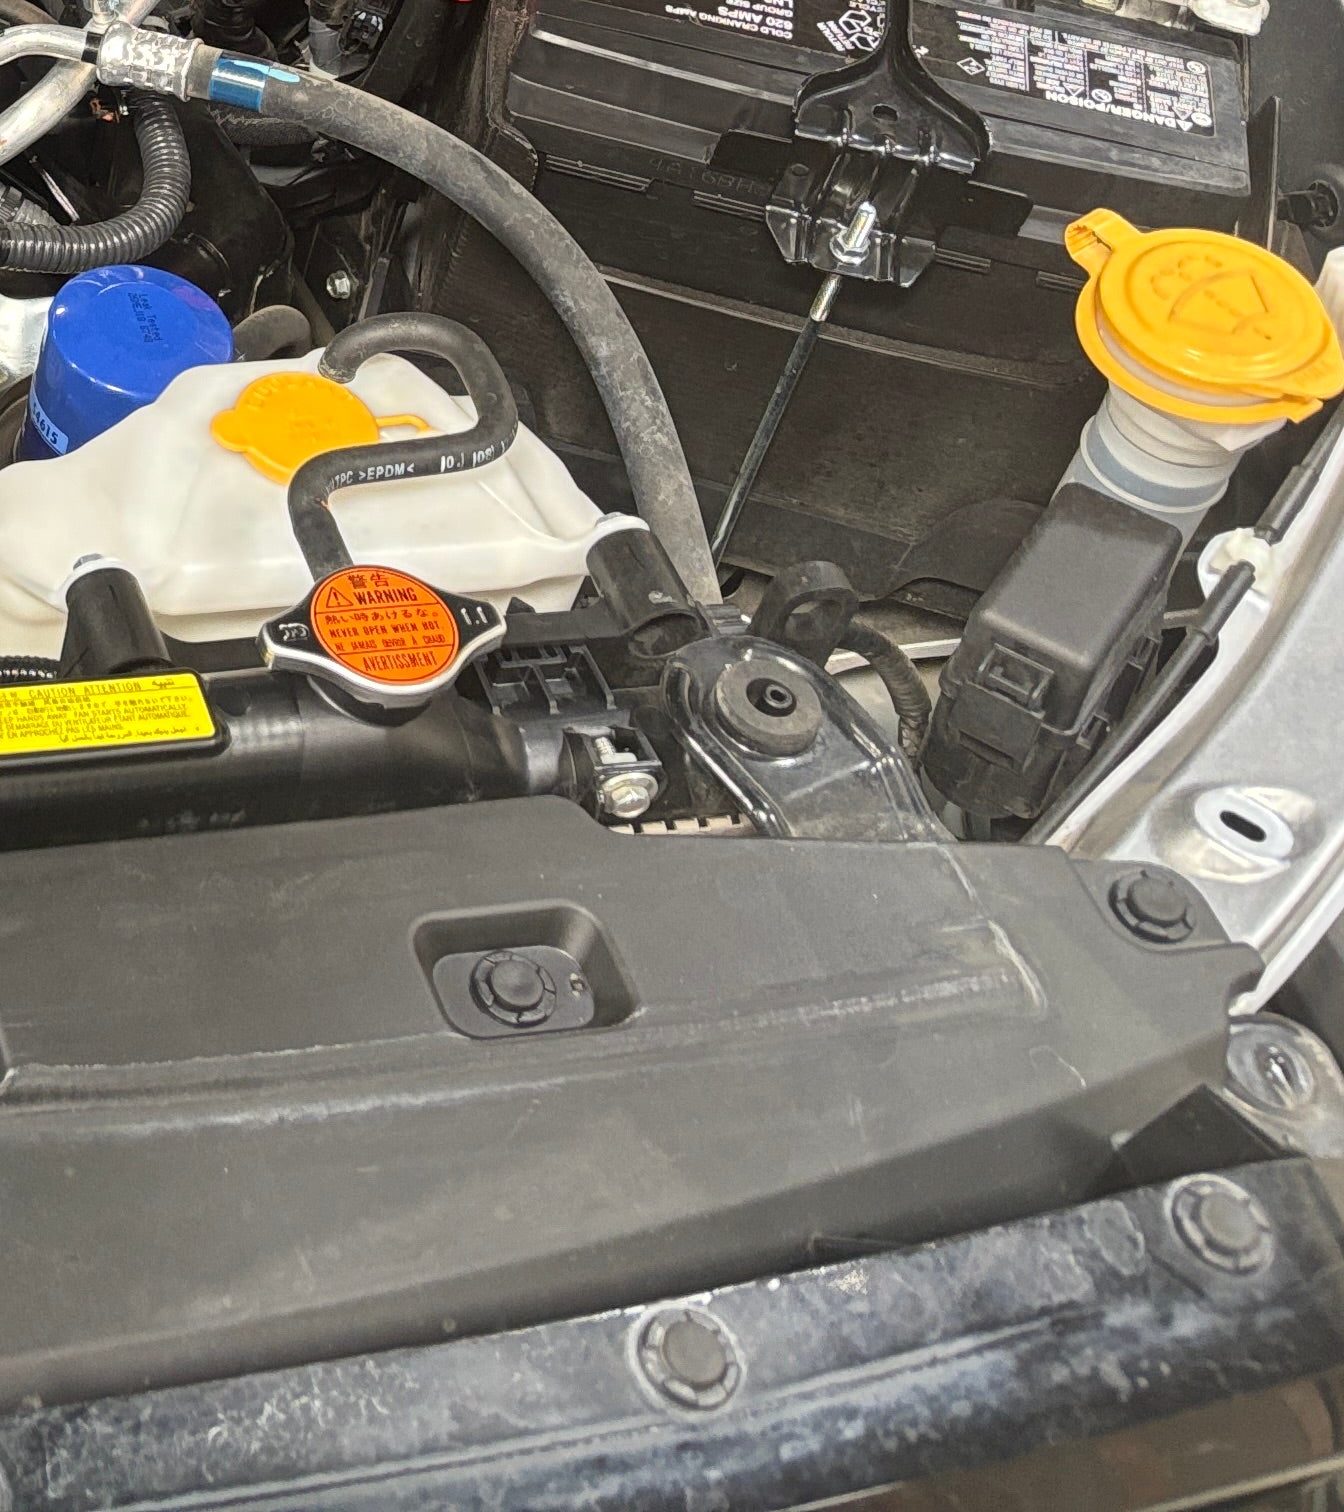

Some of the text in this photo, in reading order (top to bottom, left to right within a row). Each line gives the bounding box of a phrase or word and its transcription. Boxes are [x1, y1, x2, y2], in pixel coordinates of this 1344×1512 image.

[717, 6, 793, 31] 620 AMPS
[752, 3, 793, 18] GROUP
[664, 4, 793, 40] COLD CRANKING AMPS
[1045, 91, 1177, 129] DANGER/POISON
[358, 462, 415, 481] >EPDM<
[348, 573, 390, 588] 警告
[352, 587, 418, 605] WARNING
[329, 626, 359, 638] NEVER
[363, 625, 387, 635] OPEN
[391, 623, 418, 634] WHEN
[335, 642, 344, 652] NE
[351, 639, 377, 651] JAMAIS
[28, 681, 142, 700] CAUTION ATTENTION
[93, 708, 121, 717] STARTS
